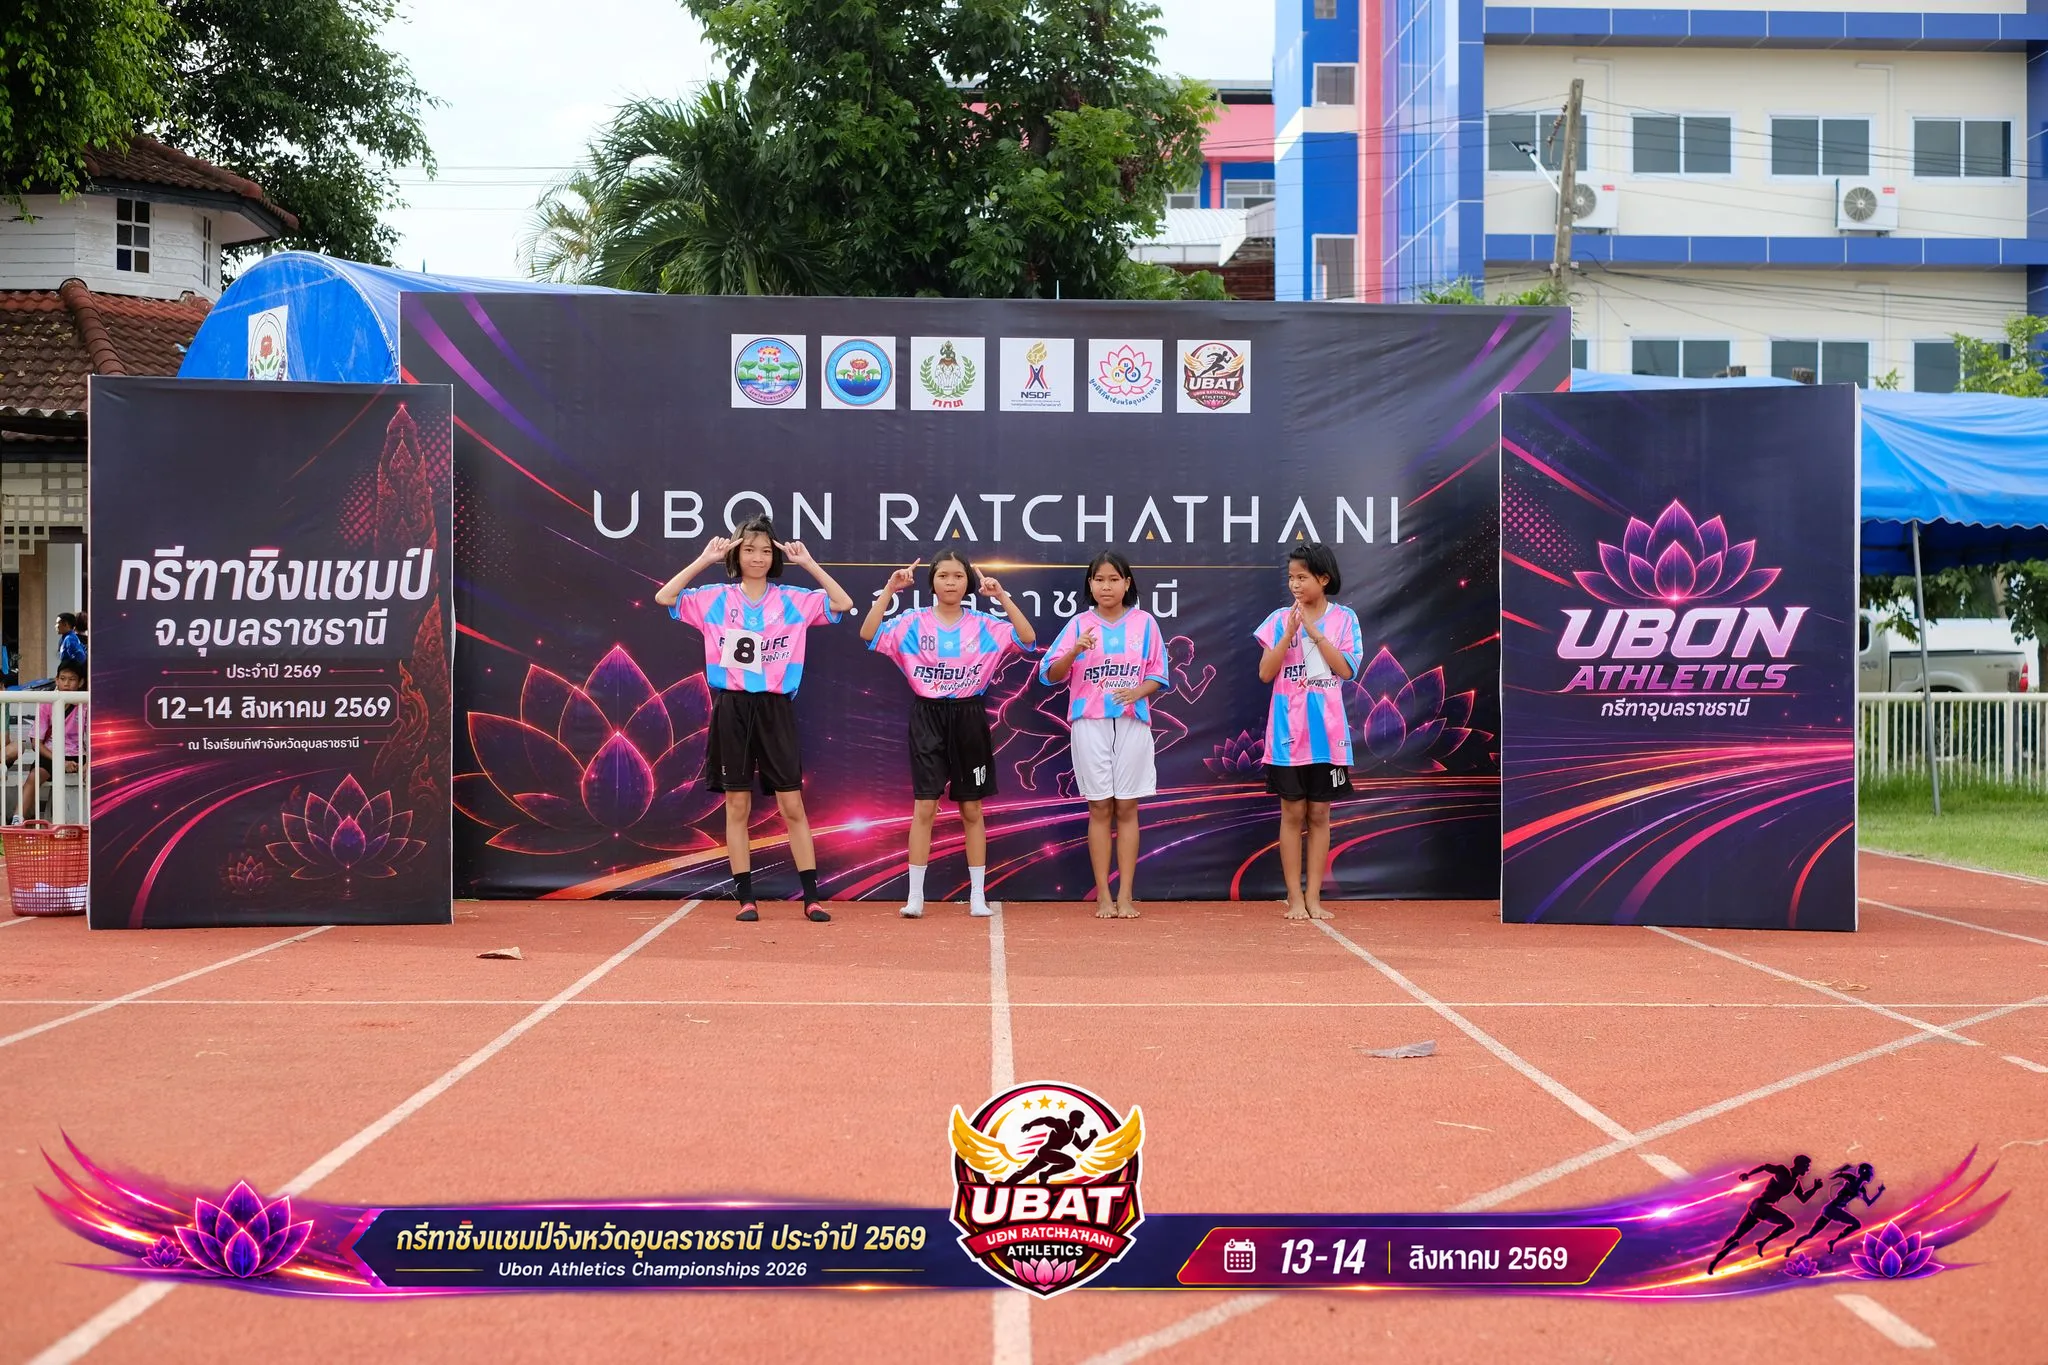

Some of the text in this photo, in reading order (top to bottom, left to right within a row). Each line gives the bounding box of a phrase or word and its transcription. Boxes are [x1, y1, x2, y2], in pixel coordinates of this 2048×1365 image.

[1189, 377, 1239, 390] UBAT
[1020, 391, 1051, 399] NSDF
[593, 489, 1402, 545] UBON RATCHATHANI
[116, 545, 434, 601] กรีฑาชิงแชมป์
[772, 635, 789, 650] FC
[920, 635, 936, 651] 88
[1556, 606, 1811, 660] UBON
[733, 637, 755, 664] 8
[226, 663, 322, 679] ประจำปี 2569
[913, 662, 966, 684] ครูท็อป
[1084, 659, 1130, 684] ครูท็อป
[1562, 663, 1797, 690] ATHLETICS
[241, 695, 327, 719] สิงหาคม
[334, 696, 391, 718] 2569
[188, 739, 200, 751] ณ
[972, 765, 987, 787] 10
[1329, 767, 1347, 788] 10
